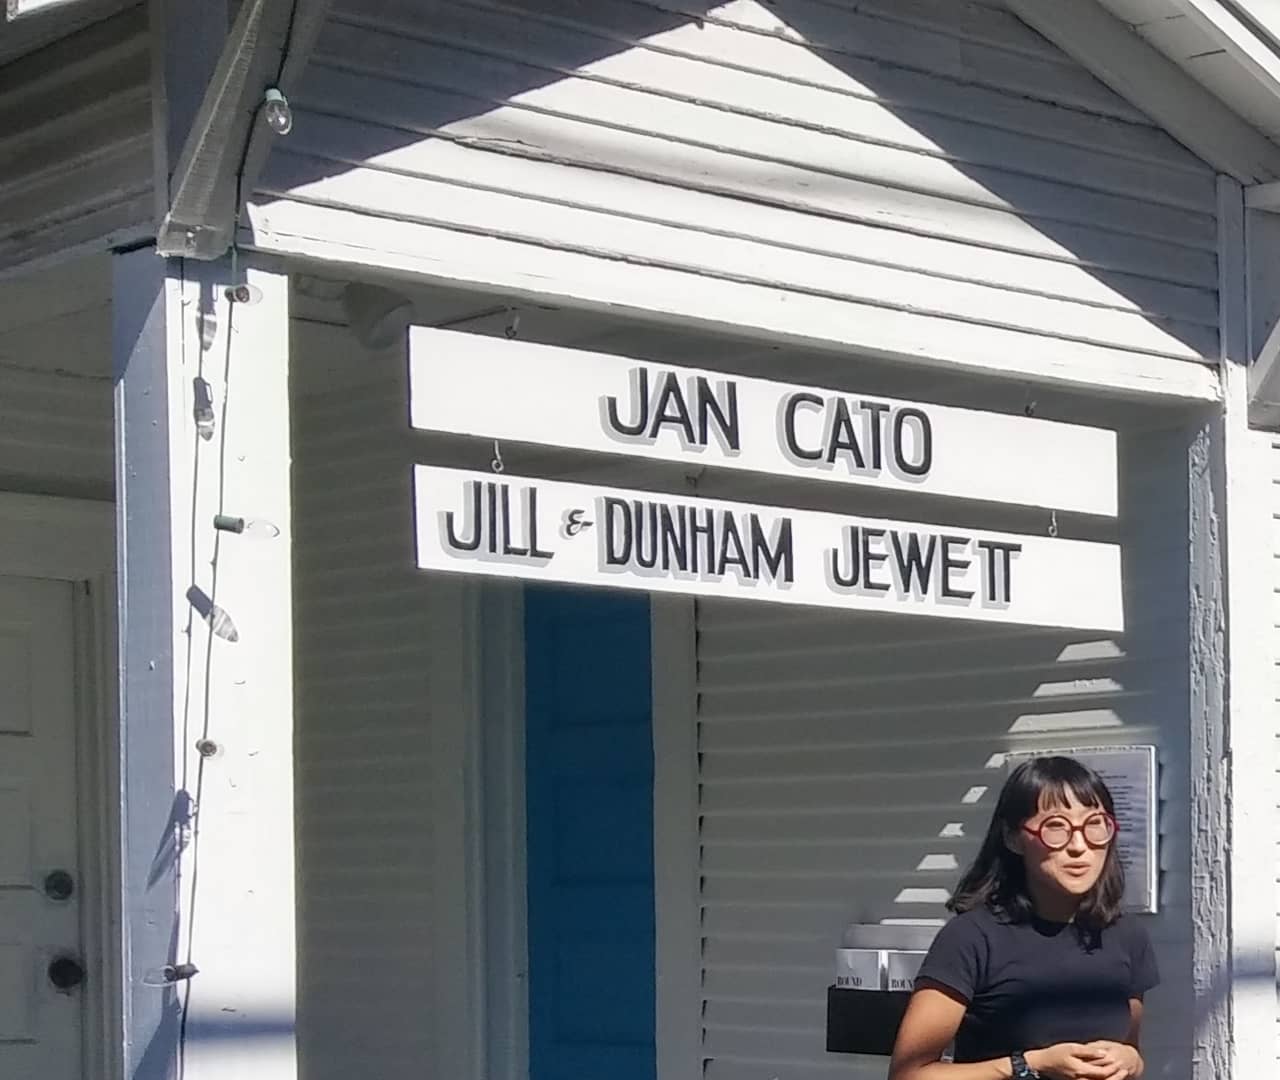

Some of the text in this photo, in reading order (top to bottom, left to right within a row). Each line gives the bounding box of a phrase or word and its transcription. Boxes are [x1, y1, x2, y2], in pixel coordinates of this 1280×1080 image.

[603, 366, 934, 478] JAN CATO
[444, 480, 1023, 603] JILL & DUNHAM JEWETT
[891, 979, 915, 988] ROUN
